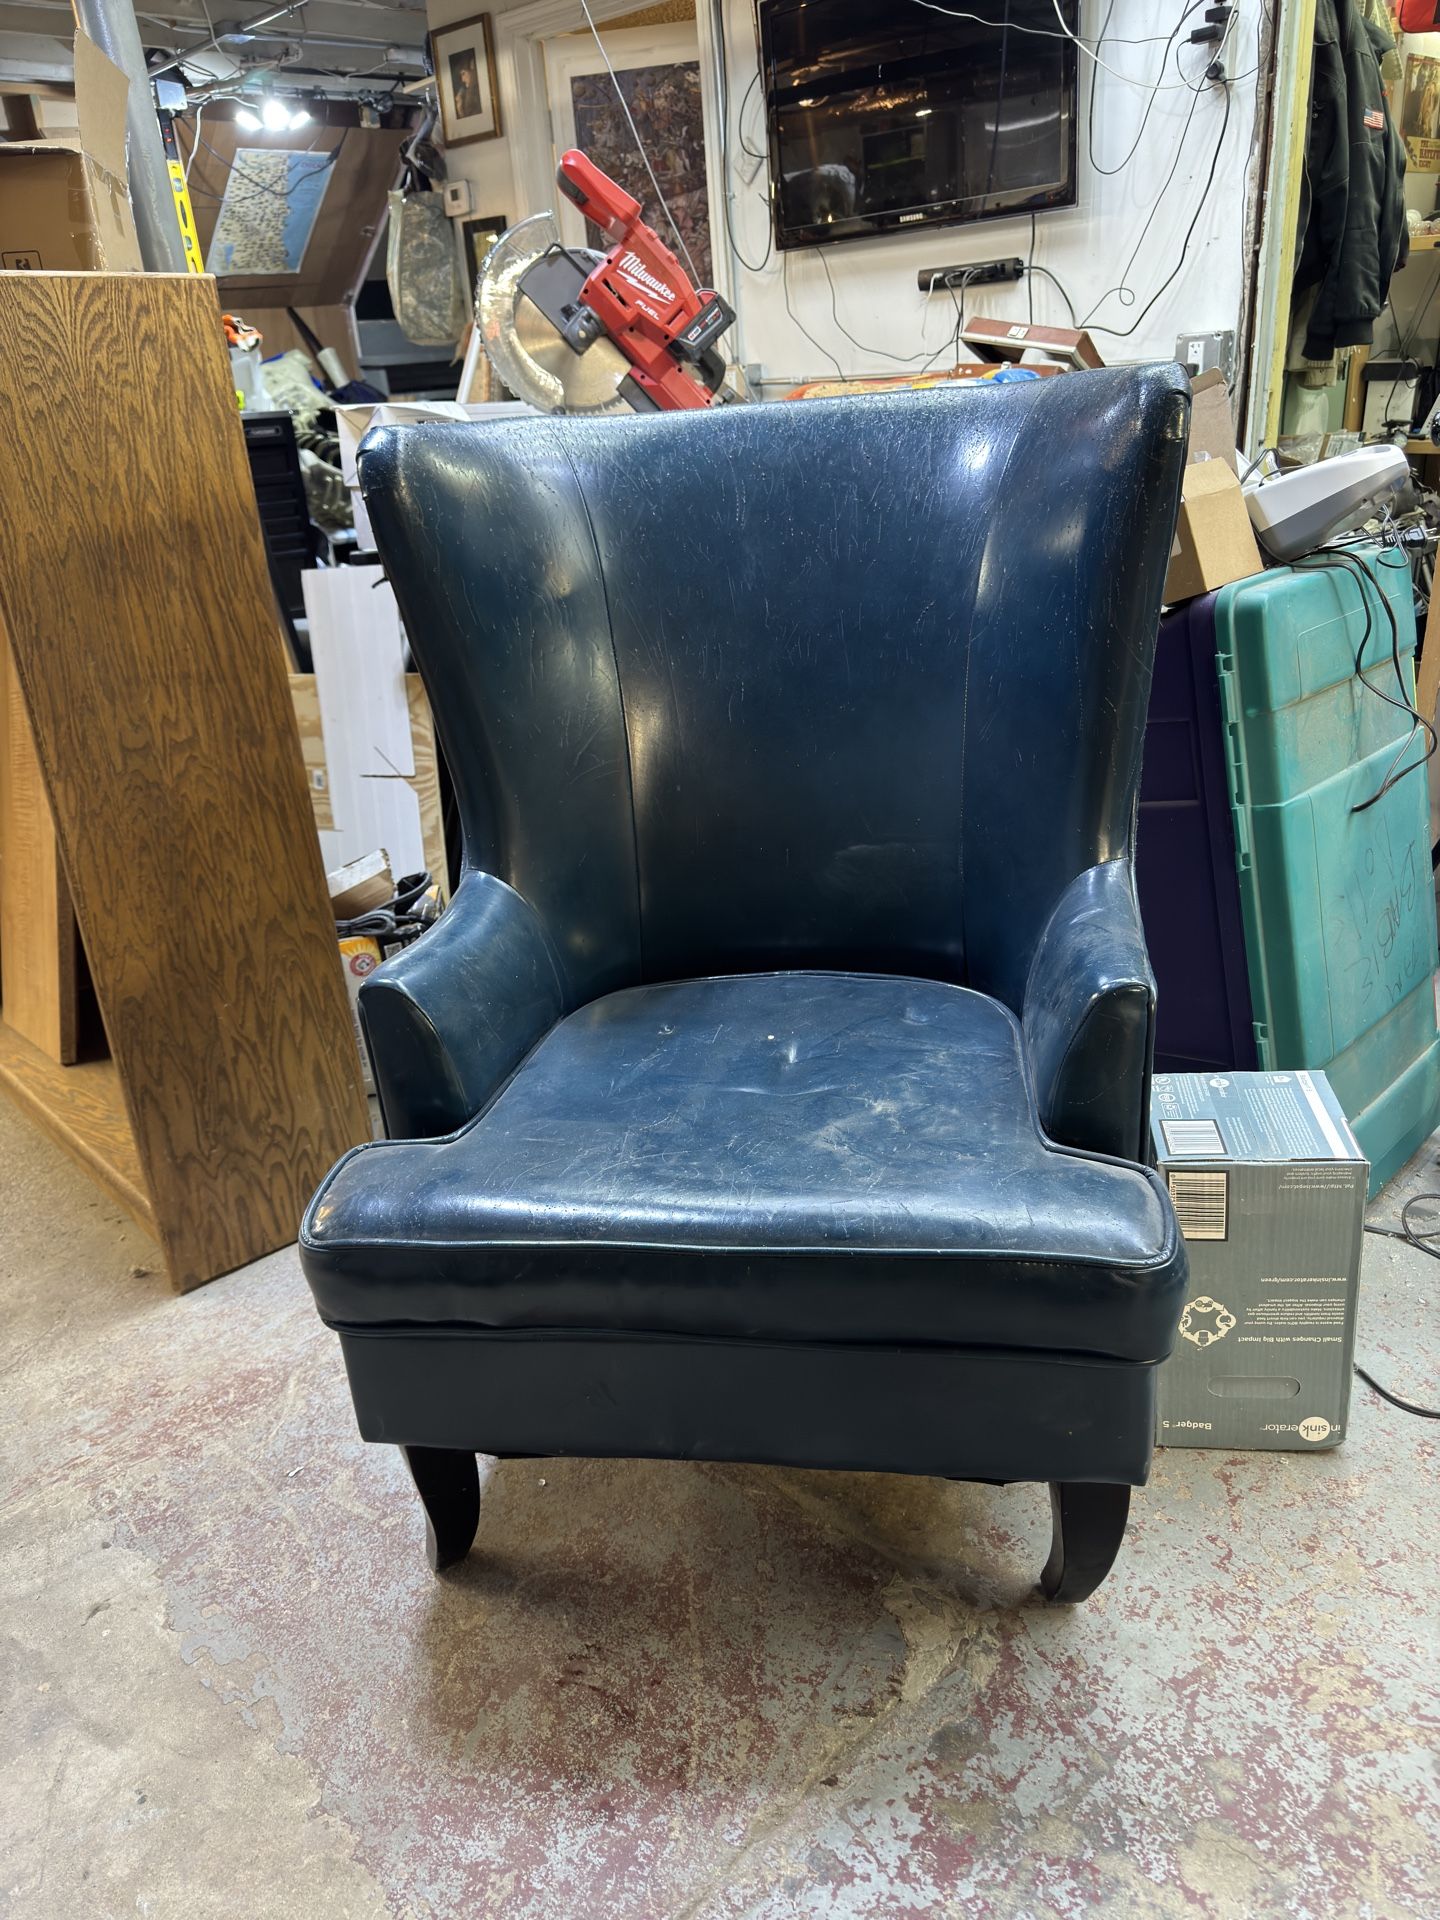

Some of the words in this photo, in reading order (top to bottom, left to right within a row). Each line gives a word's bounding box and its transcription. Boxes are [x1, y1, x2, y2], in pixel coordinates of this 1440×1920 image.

[899, 212, 923, 223] SAMSUNG
[618, 251, 676, 302] Milwaukee
[635, 299, 660, 321] FUEL
[1263, 1335, 1275, 1343] Big
[1292, 1335, 1322, 1343] Changes
[1162, 1420, 1170, 1428] 5
[1175, 1420, 1212, 1430] Badger
